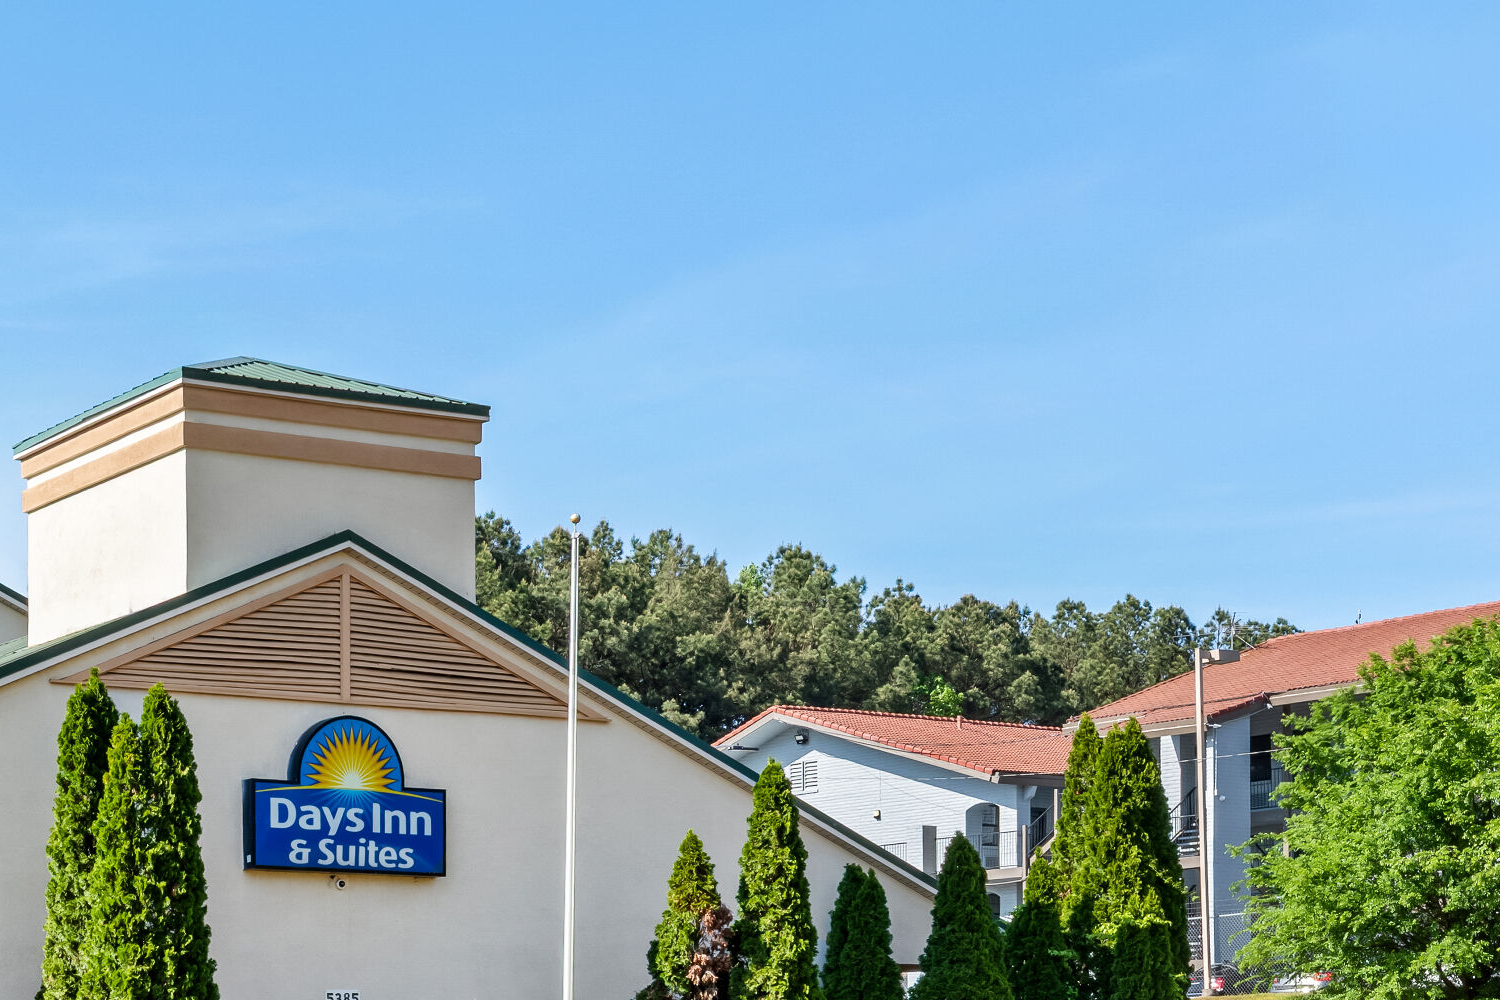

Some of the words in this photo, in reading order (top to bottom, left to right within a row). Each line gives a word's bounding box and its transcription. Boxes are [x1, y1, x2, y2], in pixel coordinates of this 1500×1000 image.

[269, 797, 365, 836] Days
[372, 802, 432, 836] Inn
[288, 839, 311, 864] &
[317, 837, 415, 869] Suites
